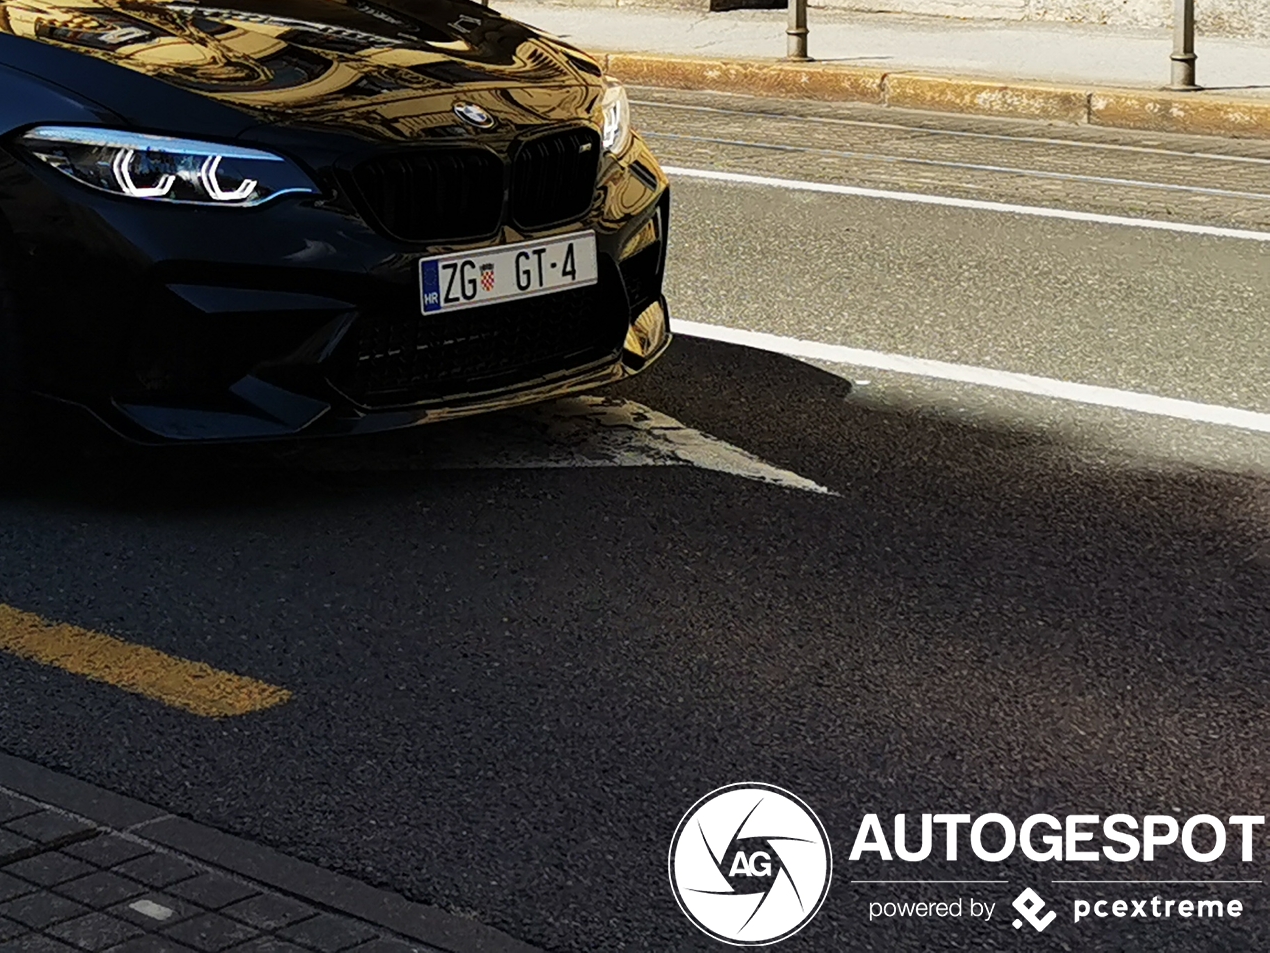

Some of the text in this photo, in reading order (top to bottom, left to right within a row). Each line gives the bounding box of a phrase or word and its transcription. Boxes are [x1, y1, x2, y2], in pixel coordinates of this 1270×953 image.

[442, 242, 577, 304] ZG GT-4
[424, 293, 439, 305] HR
